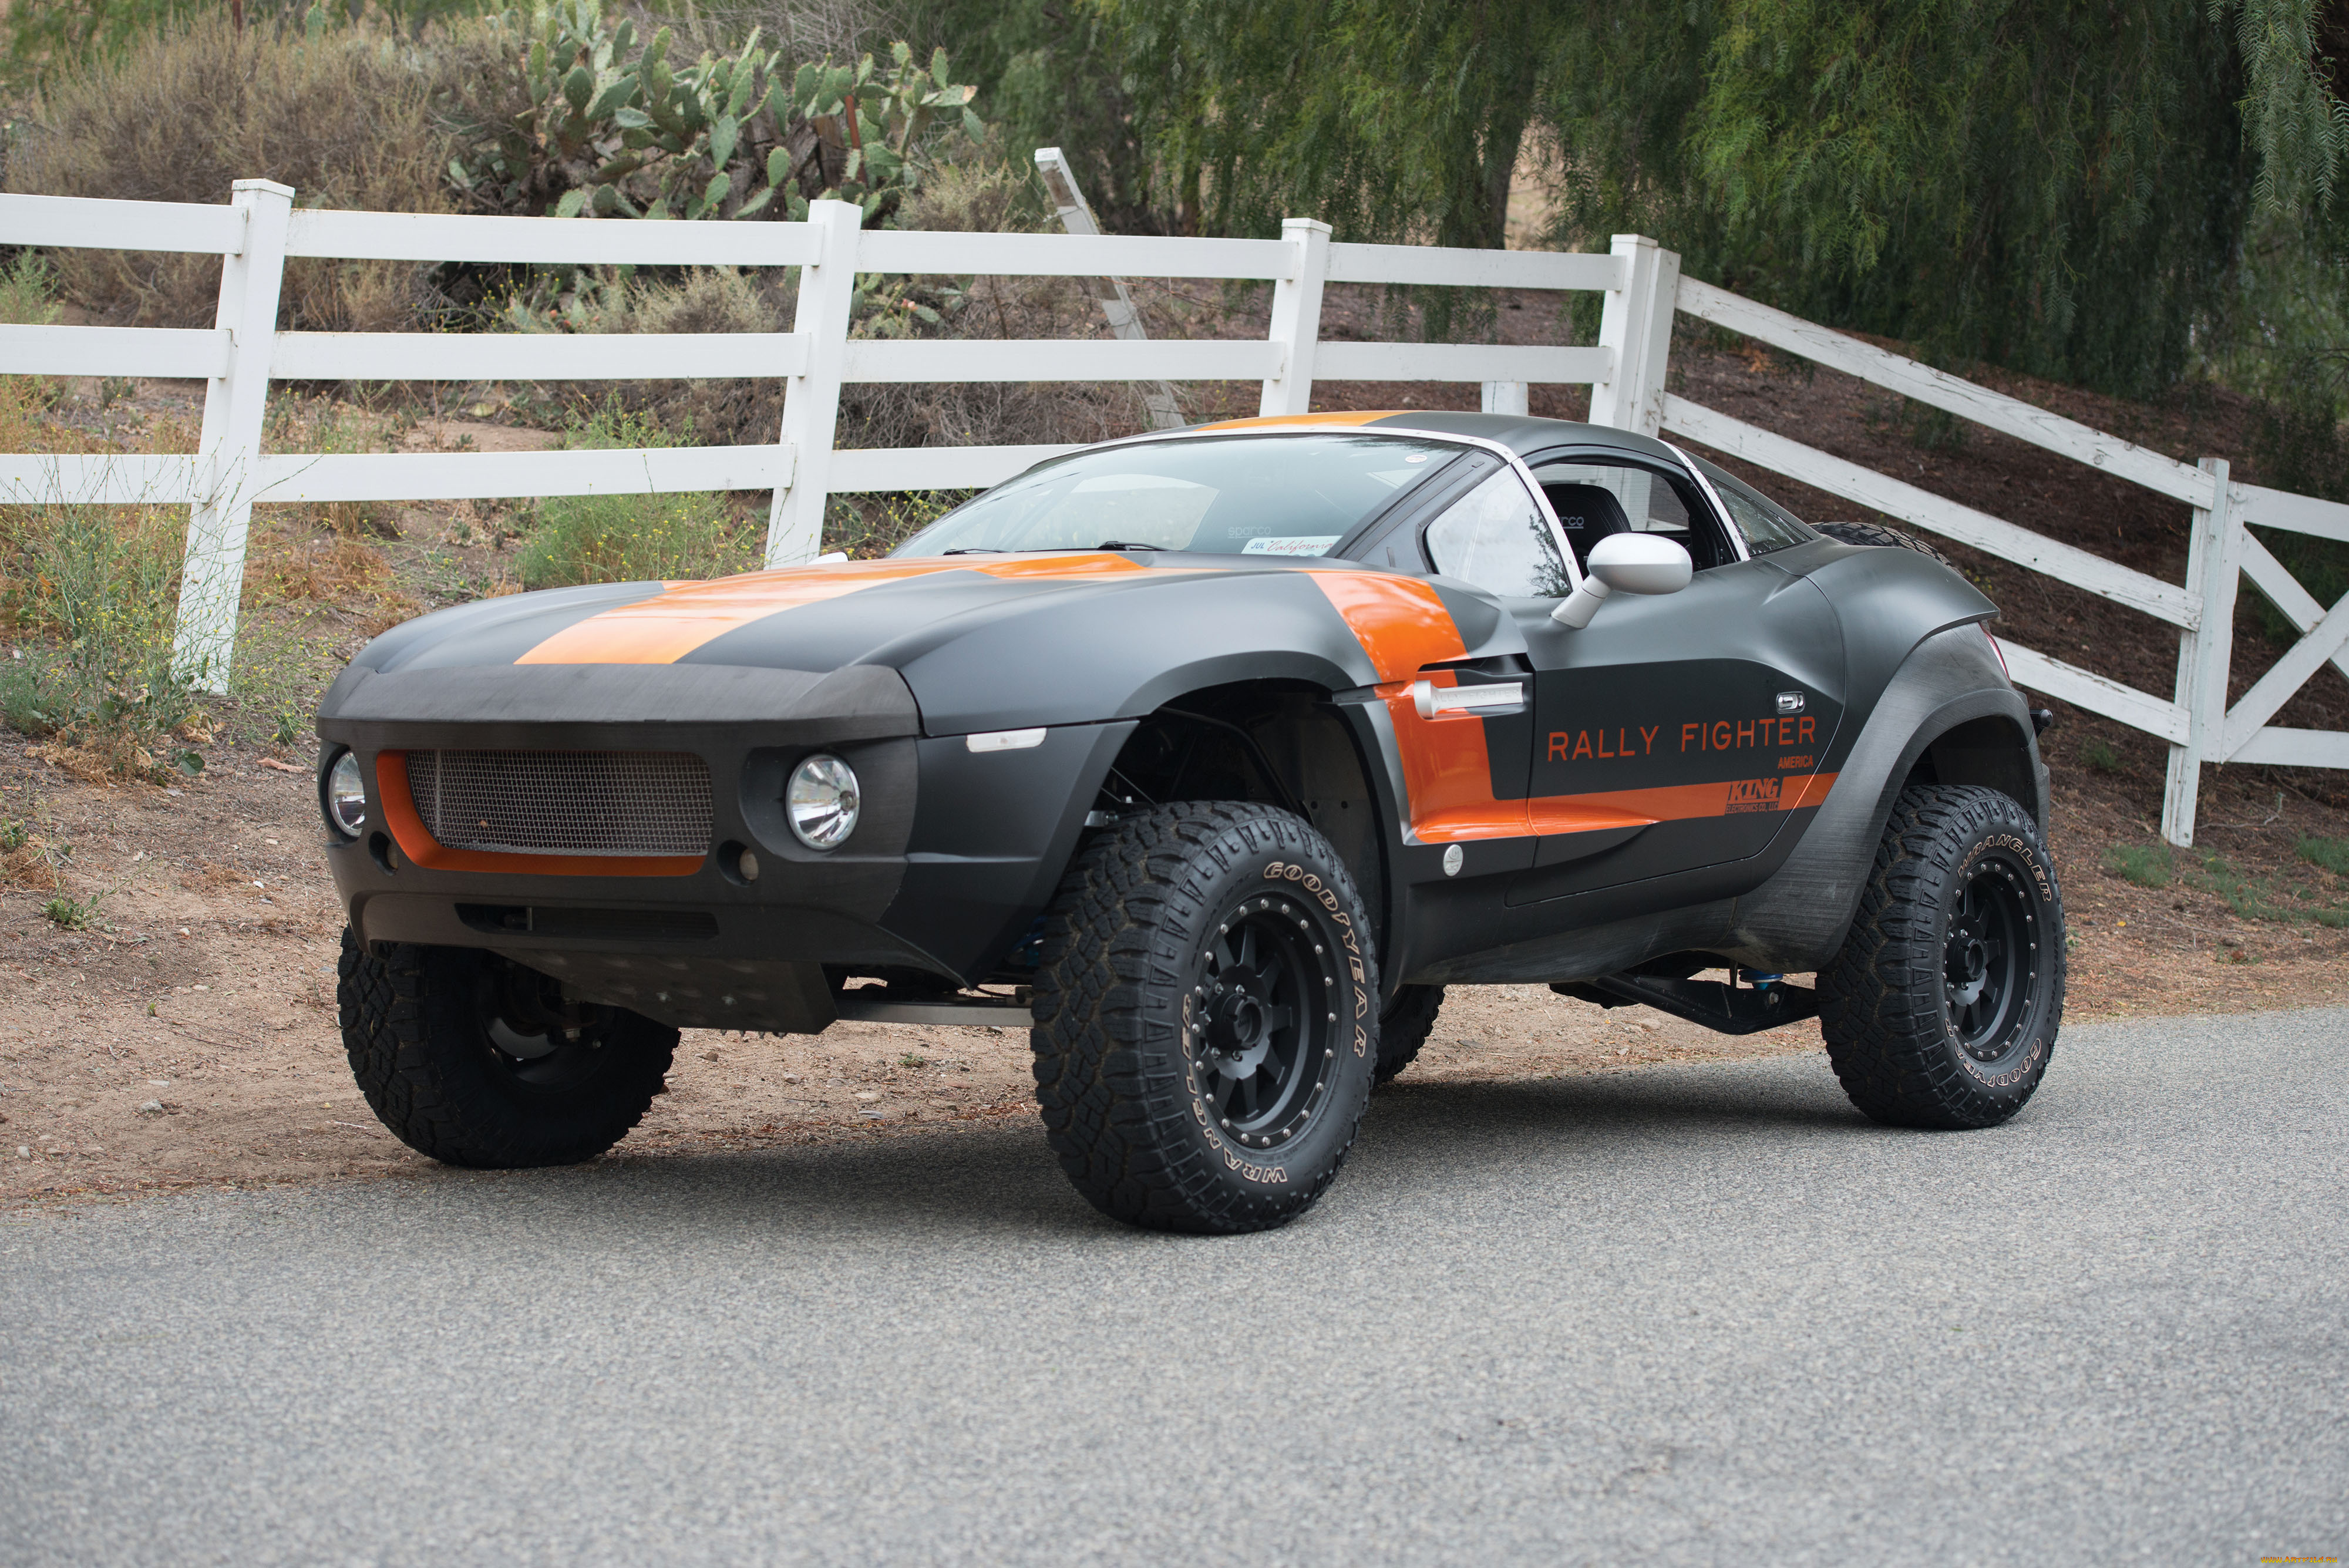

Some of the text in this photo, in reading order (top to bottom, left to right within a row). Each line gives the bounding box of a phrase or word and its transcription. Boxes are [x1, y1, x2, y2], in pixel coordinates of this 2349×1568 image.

[1227, 526, 1272, 539] sparco
[1559, 516, 1584, 527] rco
[1547, 716, 1816, 762] RALLY FIGHTER
[1778, 755, 1814, 769] AMERICA
[1728, 778, 1779, 802] KING
[1725, 805, 1758, 814] ELECTRONICS
[1768, 802, 1778, 812] LLC
[1957, 834, 2052, 903] WRANGLER
[1263, 861, 1367, 1058] GOODYEAR
[1944, 1018, 2042, 1088] GOODYEAR
[1182, 994, 1288, 1183] WRANGLER
